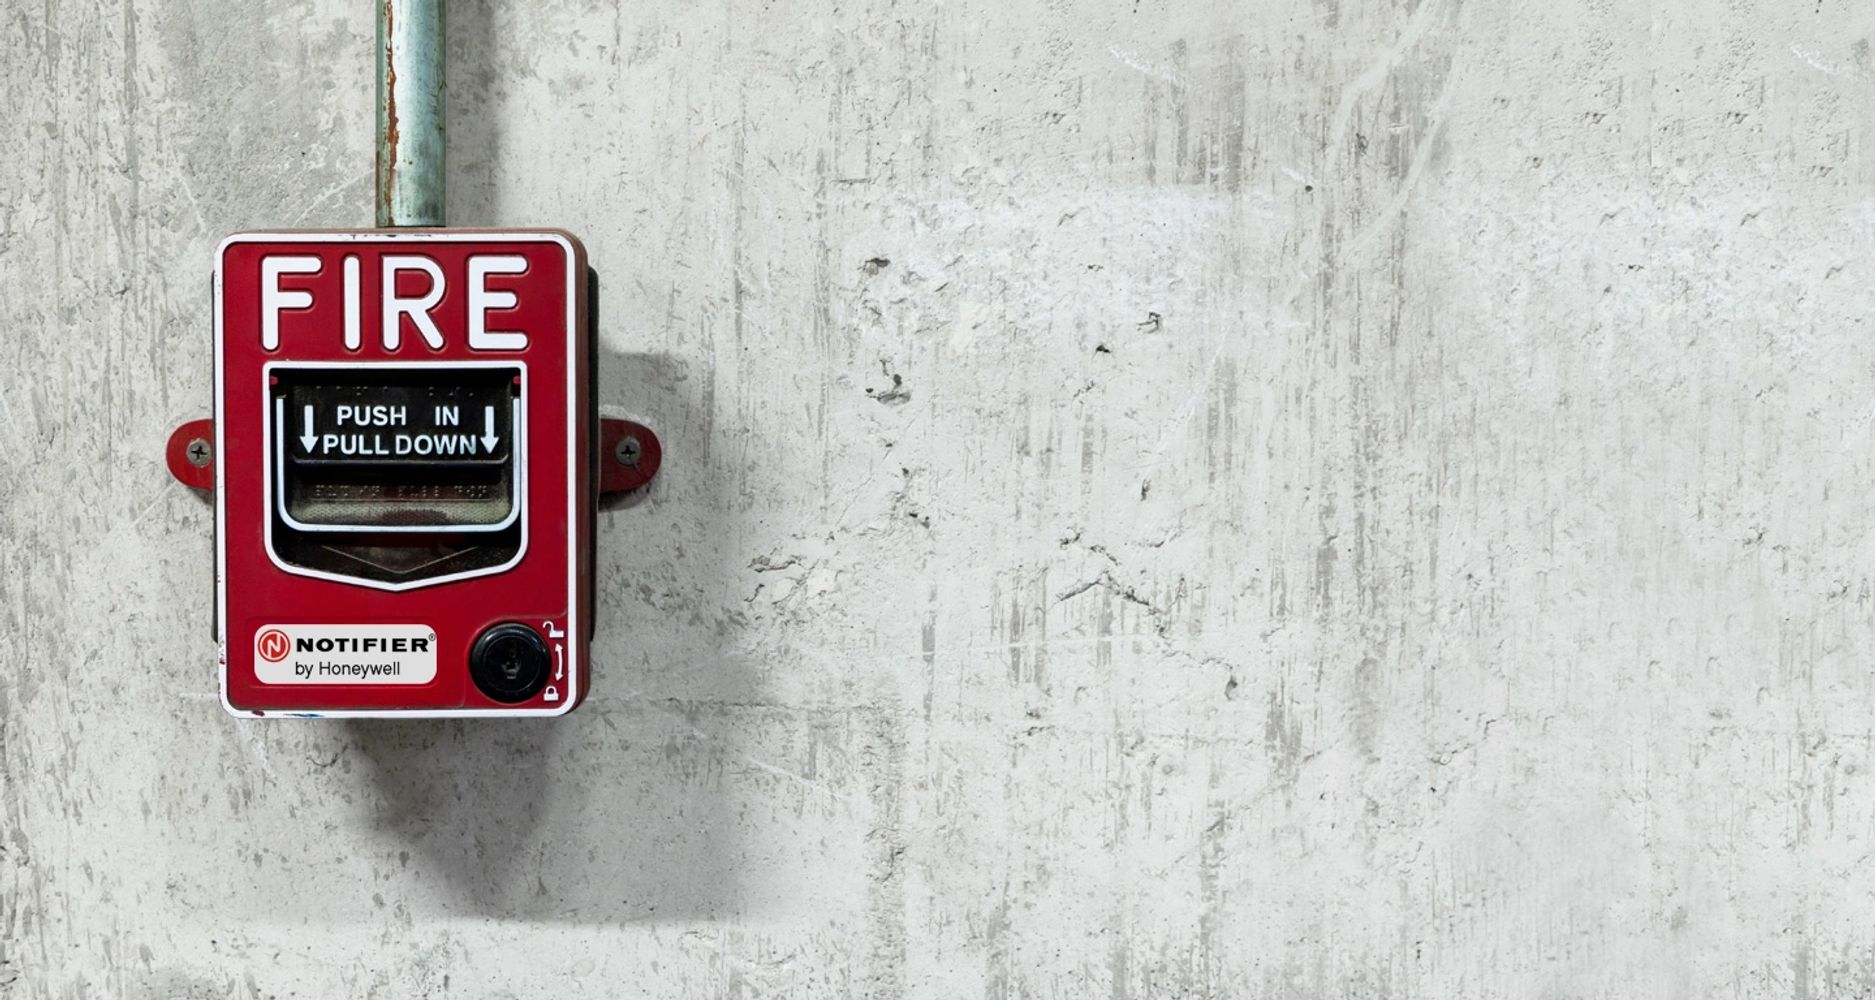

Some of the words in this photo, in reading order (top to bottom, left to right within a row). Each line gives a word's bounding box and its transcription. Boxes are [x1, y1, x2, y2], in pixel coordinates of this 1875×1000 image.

[261, 256, 529, 351] FIRE
[336, 405, 407, 427] PUSH
[435, 405, 459, 427] IN
[322, 434, 389, 456] PULL
[395, 434, 477, 456] DOWN
[295, 661, 314, 680] by
[319, 661, 401, 680] Honeywell
